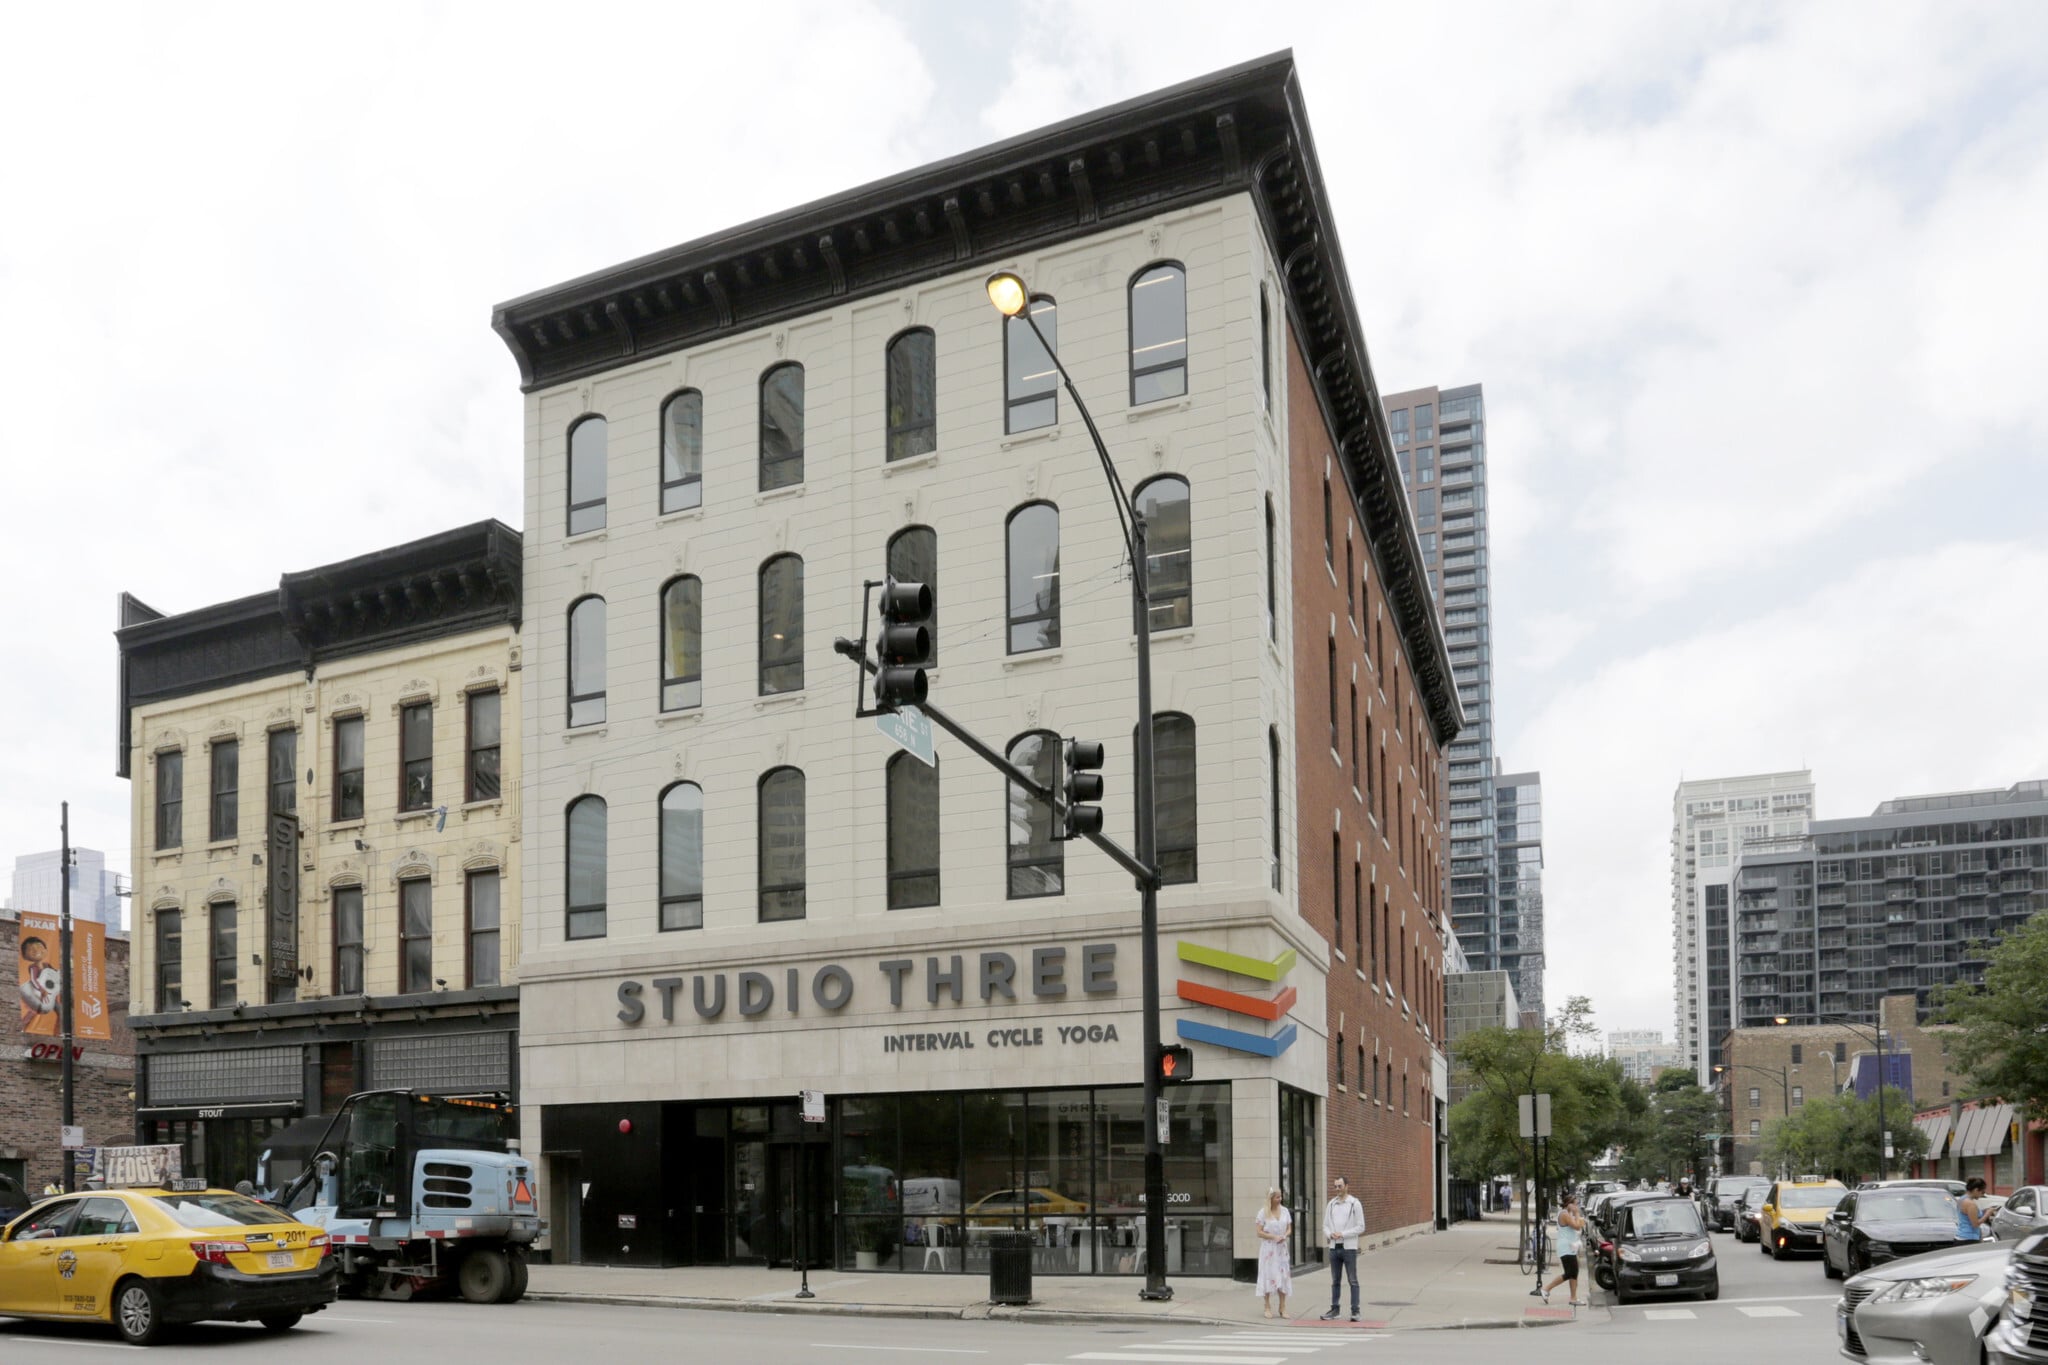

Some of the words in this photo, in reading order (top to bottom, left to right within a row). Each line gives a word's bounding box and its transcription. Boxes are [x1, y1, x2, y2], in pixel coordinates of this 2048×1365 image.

[23, 919, 56, 931] PIXAR
[617, 965, 853, 1025] STUDIO
[880, 943, 1117, 1006] THREE
[883, 1032, 974, 1053] INTERVAL
[987, 1027, 1043, 1047] CYCLE
[1058, 1023, 1119, 1044] YOGA
[31, 1043, 84, 1061] OPN
[199, 1109, 224, 1118] STOUT
[106, 1156, 160, 1184] LEDGE
[285, 1230, 306, 1242] 2011
